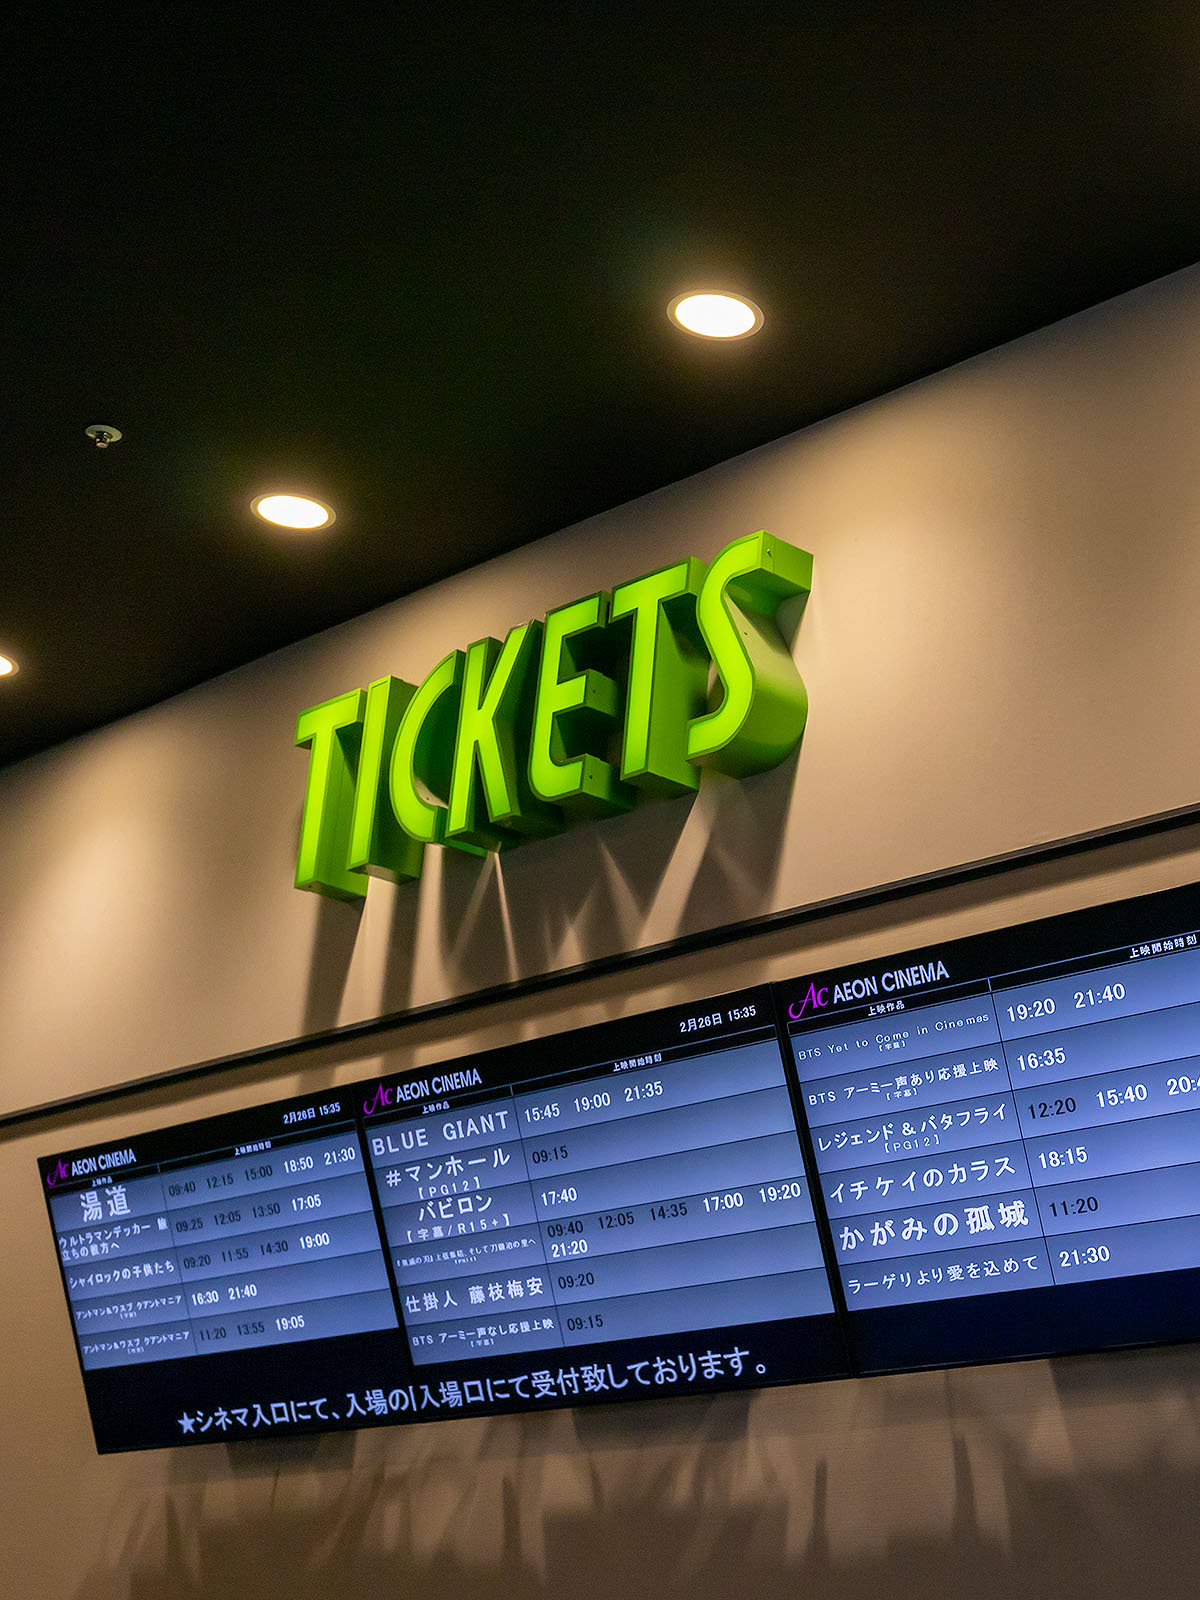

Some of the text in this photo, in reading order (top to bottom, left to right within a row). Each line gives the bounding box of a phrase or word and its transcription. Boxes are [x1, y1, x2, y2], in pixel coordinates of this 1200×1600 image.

[294, 530, 812, 897] TICKETS
[833, 975, 879, 1005] AEON
[881, 960, 950, 993] CINEMA
[679, 1005, 757, 1033] 2月26日 15:35
[1006, 983, 1126, 1023] 19:20 21:40
[798, 1014, 990, 1061] BTS Yet to Come in Cinemas
[1017, 1047, 1066, 1072] 16:35
[396, 1081, 429, 1103] AEON
[432, 1068, 482, 1094] CINEMA
[808, 1090, 837, 1107] BTS
[1028, 1097, 1077, 1120] 12:20
[1096, 1083, 1148, 1108] 15:40
[319, 1102, 341, 1116] 15:35
[524, 1081, 664, 1123] 15:45 19:00 21:35
[371, 1110, 509, 1156] BLUE GIANT
[71, 1157, 97, 1177] AEON
[98, 1148, 137, 1170] CINEMA
[532, 1145, 569, 1165] 09:15
[1038, 1146, 1088, 1169] 18:15
[168, 1147, 356, 1197] 09:40 12:15 15:00 18:50 21:30
[830, 1156, 1016, 1204] イチケイのカラス
[80, 1185, 131, 1223] 湯道
[175, 1217, 204, 1233] 09:25
[213, 1210, 242, 1226] 12:05
[251, 1202, 281, 1219] 13:50
[291, 1193, 322, 1212] 17:05
[419, 1194, 492, 1222] バビロン
[541, 1187, 578, 1207] 17:40
[547, 1182, 801, 1239] 09:40 12:05 14:35 17:00 19:20
[1050, 1196, 1099, 1218] 11:20
[840, 1199, 1029, 1251] かがみの孤城
[183, 1232, 331, 1269] 09:20 11:55 14:30 19:00
[551, 1239, 589, 1259] 21:20
[1059, 1245, 1111, 1267] 21:30
[558, 1272, 595, 1290] 09:20
[848, 1255, 1039, 1295] ラーゲリより愛を込めて
[191, 1283, 258, 1307] 16:30 21:40
[405, 1277, 544, 1314] 仕掛人 藤枝梅安
[199, 1315, 305, 1342] 11:20 13:55 19:05
[567, 1314, 604, 1332] 09:15
[412, 1334, 434, 1347] BTS
